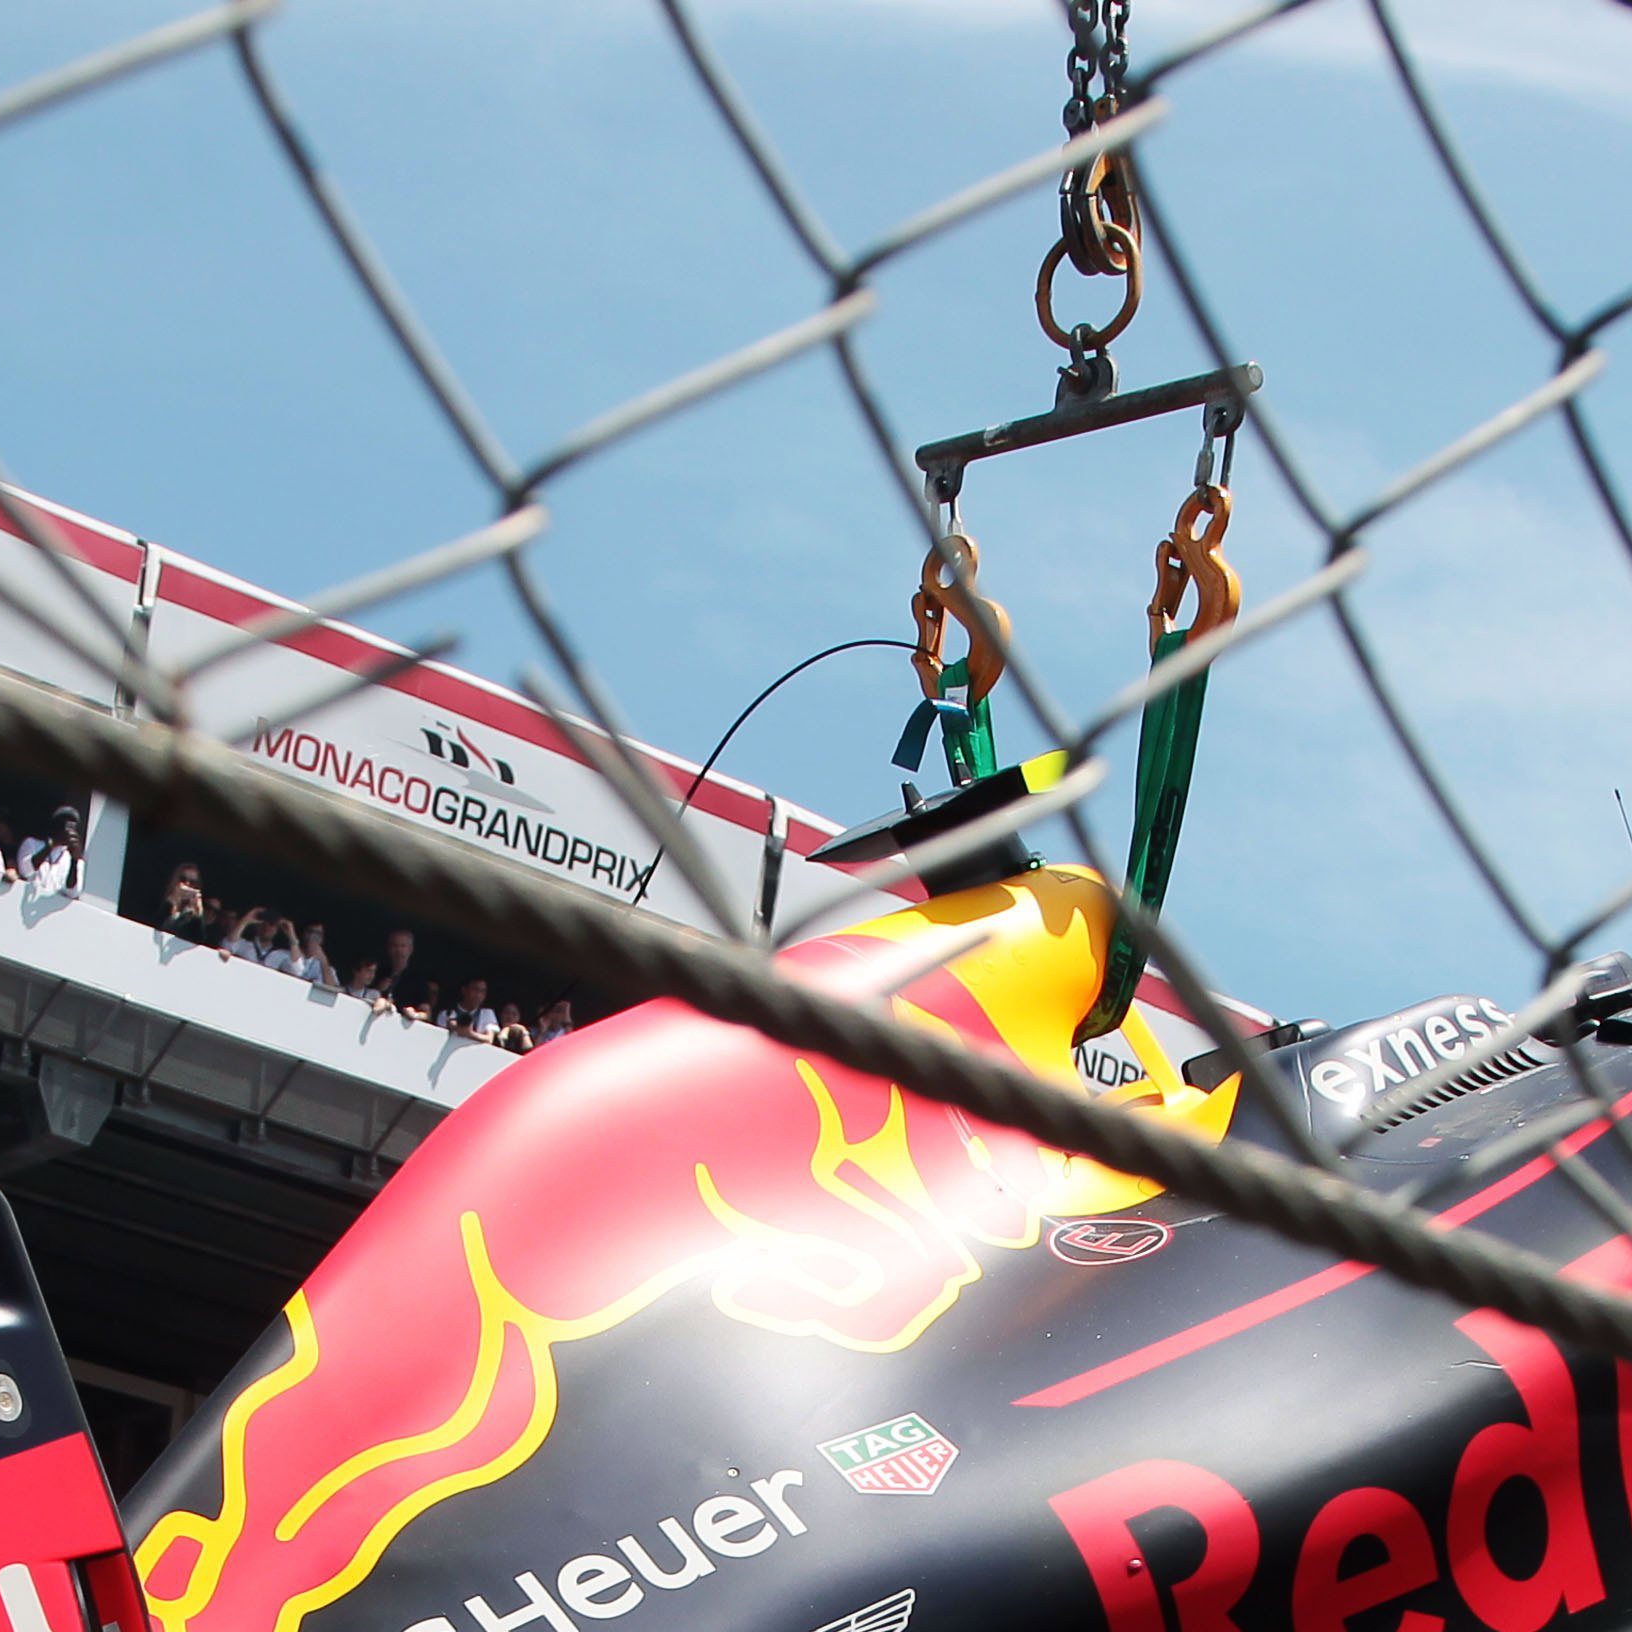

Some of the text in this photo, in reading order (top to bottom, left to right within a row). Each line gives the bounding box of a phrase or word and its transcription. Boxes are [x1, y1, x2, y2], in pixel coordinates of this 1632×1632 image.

[1310, 998, 1515, 1102] exness
[830, 1421, 926, 1463] TAG
[853, 1442, 949, 1489] HEUER
